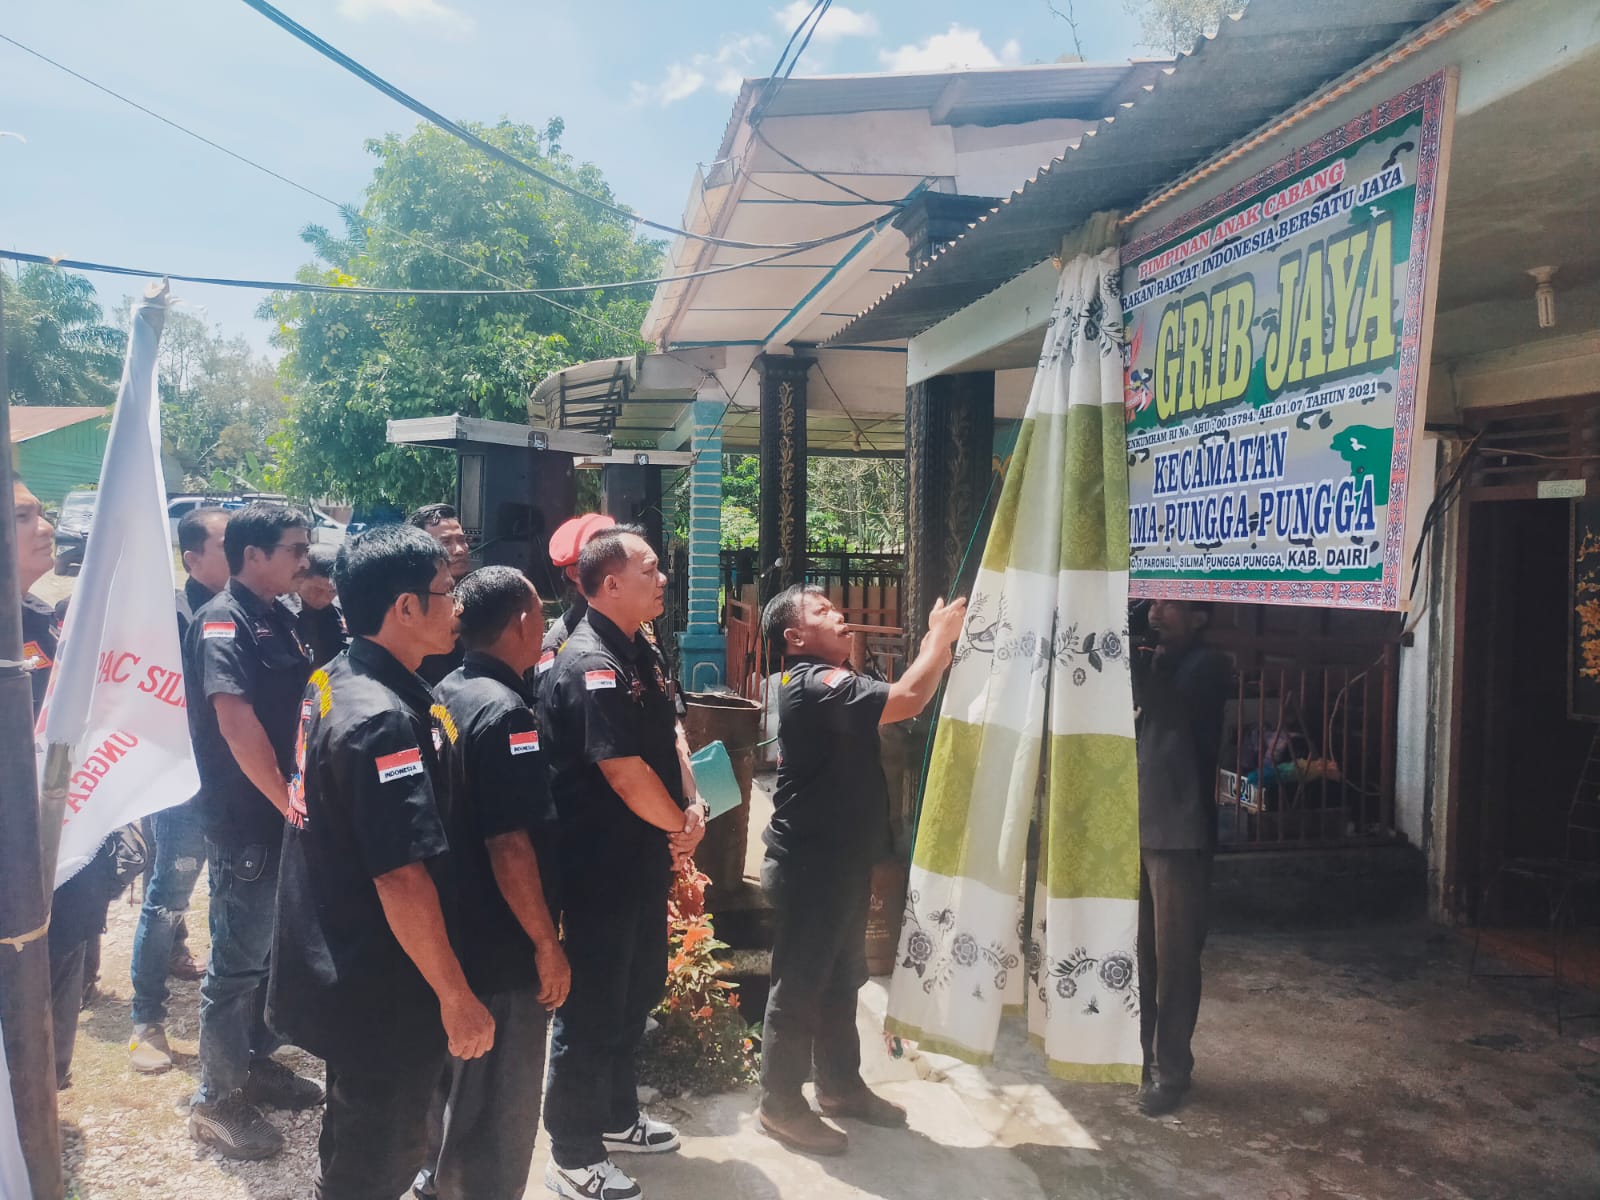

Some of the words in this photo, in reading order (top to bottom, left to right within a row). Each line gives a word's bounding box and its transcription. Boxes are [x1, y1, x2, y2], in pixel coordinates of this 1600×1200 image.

[1120, 285, 1154, 311] RAKAN
[1156, 263, 1199, 296] RAKYAT
[1201, 227, 1274, 275] INDONESIA
[1278, 189, 1354, 240] BERSATU
[1359, 166, 1402, 202] JAYA
[1139, 231, 1210, 279] PIMPINAN
[1214, 205, 1260, 241] ANAK
[1264, 162, 1344, 217] CABANG
[1156, 280, 1252, 420] GRIB
[1265, 220, 1395, 391] JAYA
[1127, 432, 1167, 449] ENKUMHAM
[1258, 400, 1302, 420] AH.01.07
[1305, 388, 1345, 409] TAHUN
[1348, 382, 1376, 399] 2021
[1154, 431, 1288, 494] KECAMATAN
[1128, 506, 1157, 544] IMA
[1164, 494, 1249, 543] PUNGGA
[1258, 480, 1376, 537] PUNGGA
[1144, 558, 1178, 569] PARONGIL,
[1180, 557, 1204, 567] SILIMA
[1206, 556, 1241, 567] PUNGGA
[1243, 555, 1284, 568] PUNGGA,
[1288, 550, 1321, 566] KAB.
[1326, 548, 1368, 566] DAIRI
[137, 665, 186, 707] SIL
[385, 765, 417, 778] INDONESIA
